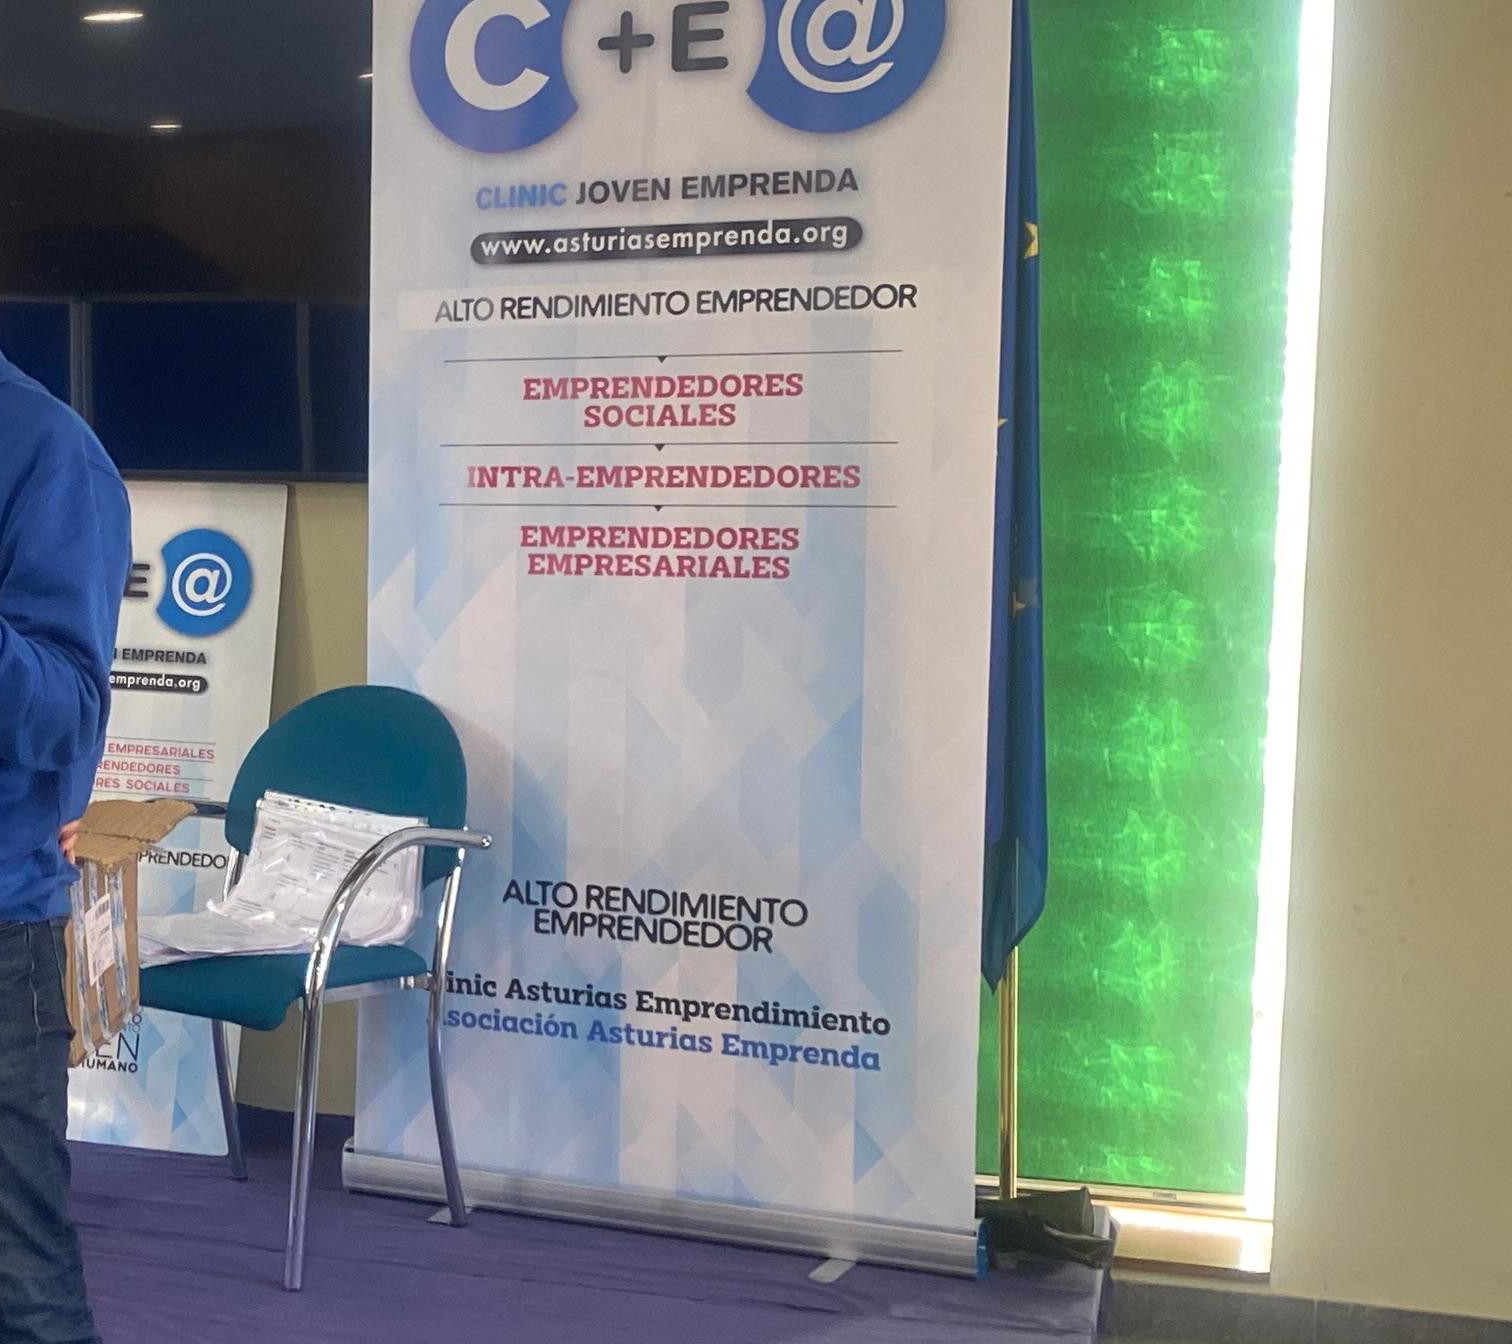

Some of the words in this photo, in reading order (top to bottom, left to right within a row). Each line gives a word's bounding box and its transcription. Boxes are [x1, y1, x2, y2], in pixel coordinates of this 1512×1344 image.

[475, 181, 568, 210] CLINIC
[575, 177, 671, 206] JOVEN
[680, 167, 859, 200] EMPRENDA
[480, 220, 849, 257] www.asturiasemprenda.org
[434, 296, 494, 324] ALTO
[499, 290, 690, 321] RENDIMIENTO
[695, 283, 918, 316] EMPRENDEDOR
[522, 373, 804, 400] EMPRENDEDORES
[583, 403, 737, 428] SOCIALES
[466, 464, 861, 489] INTRA-EMPRENDEDORES
[520, 525, 800, 551] EMPRENDEDORES
[527, 552, 791, 579] EMPRESARIALES
[172, 552, 233, 617] @
[122, 648, 207, 665] EMPRENDA
[108, 673, 202, 692] emprenda.org
[107, 742, 215, 760] EMPRESARIALES
[97, 759, 181, 775] RENDEDORES
[126, 779, 190, 793] SOCIALES
[138, 849, 227, 869] PRENDEDO
[501, 878, 578, 908] ALTO
[585, 884, 809, 927] RENDIMIENTO
[534, 908, 774, 954] EMPRENDEDOR
[446, 970, 497, 998] inic
[504, 977, 628, 1011] Asturias
[635, 989, 891, 1036] Emprendimiento
[443, 1007, 578, 1040] sociación
[587, 1019, 713, 1054] Asturias
[720, 1032, 881, 1071] Emprenda
